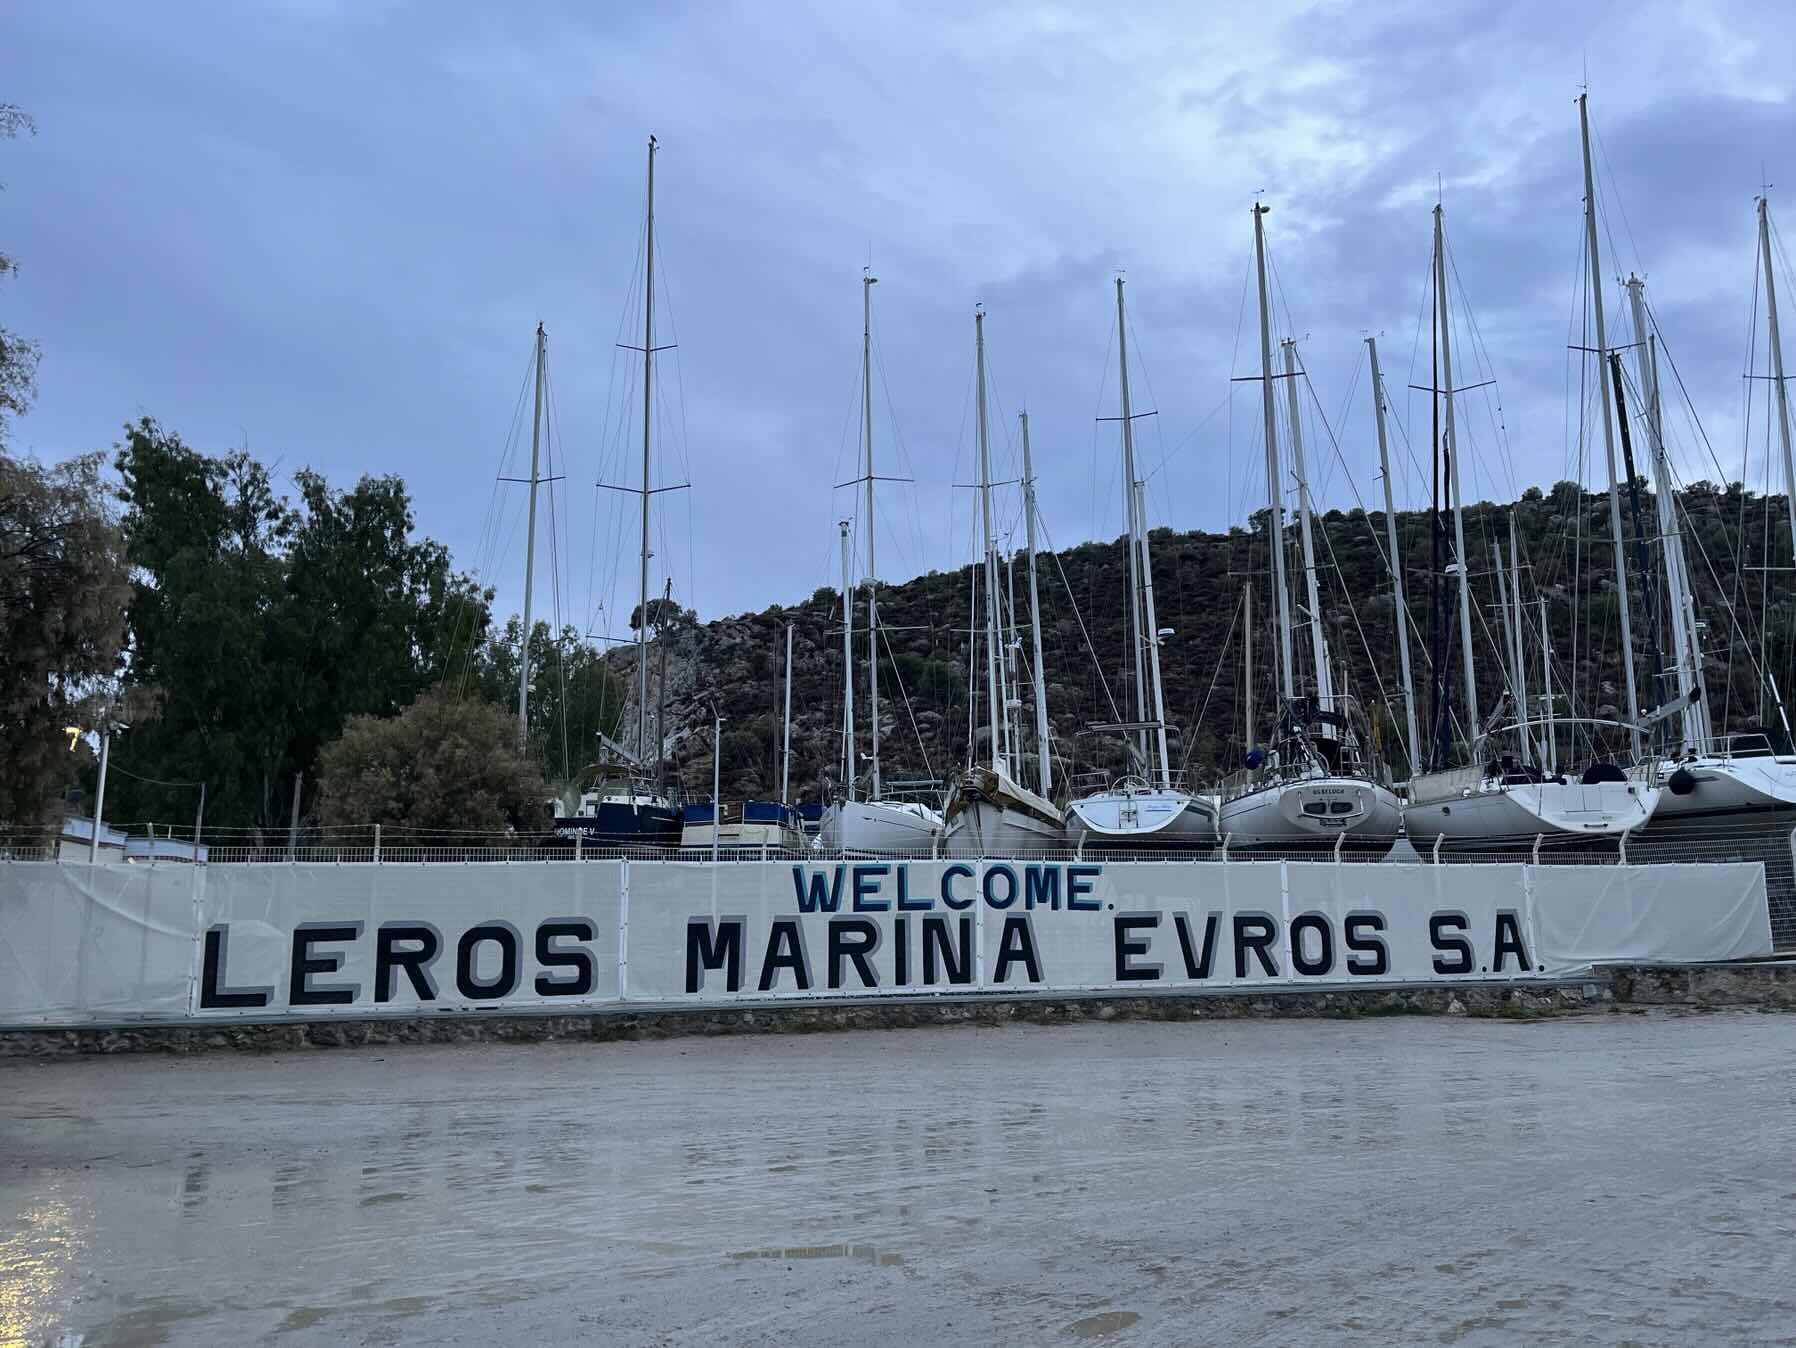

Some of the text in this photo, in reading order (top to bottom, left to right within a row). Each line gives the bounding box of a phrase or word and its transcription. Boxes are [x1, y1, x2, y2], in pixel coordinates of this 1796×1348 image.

[792, 864, 1114, 913] WELCOME.
[201, 909, 1545, 1008] LEROS MARINA EVROS S.A.
